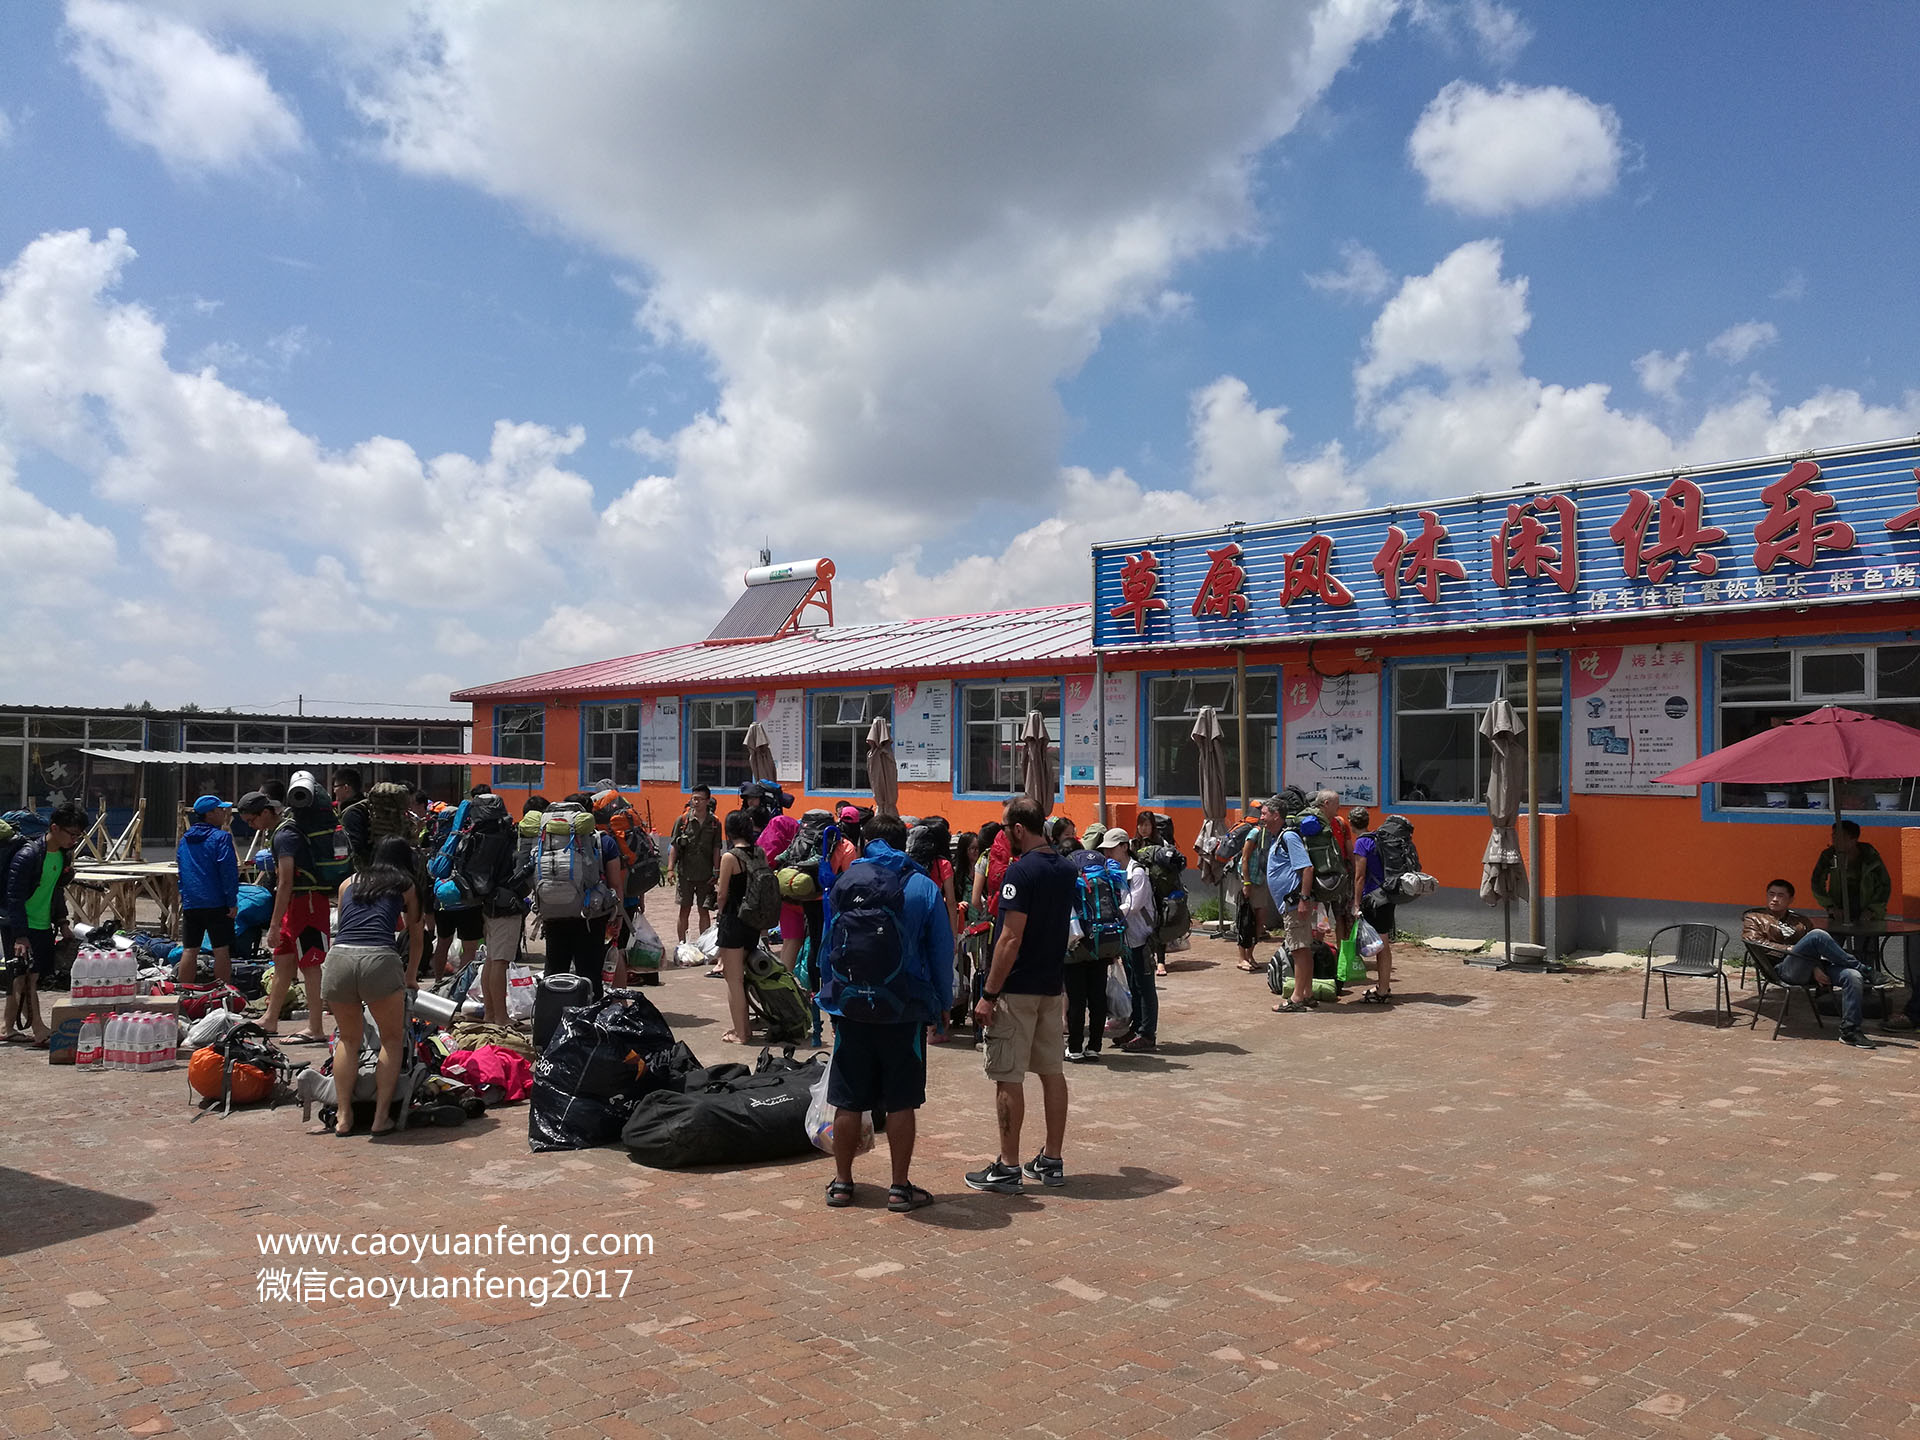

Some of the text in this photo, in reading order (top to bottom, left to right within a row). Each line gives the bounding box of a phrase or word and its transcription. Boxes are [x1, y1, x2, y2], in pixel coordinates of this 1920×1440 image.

[1110, 460, 1920, 634] 草原风休闲俱乐
[1588, 566, 1917, 611] 停车住宿 餐饮娱乐 特色烤
[1578, 650, 1609, 680] 吃
